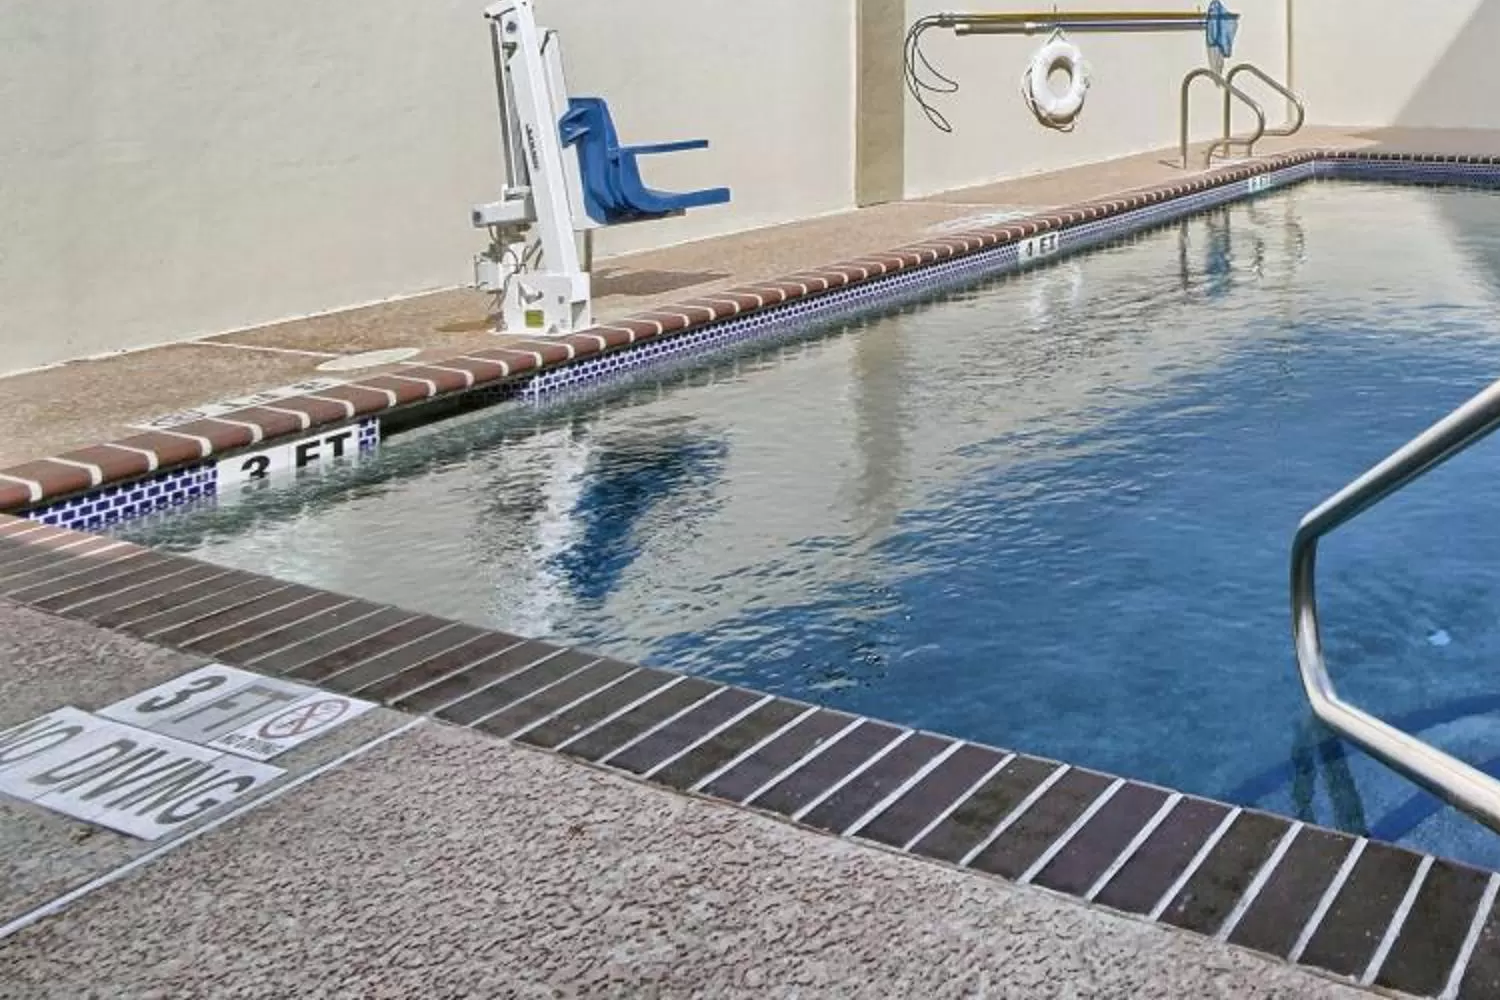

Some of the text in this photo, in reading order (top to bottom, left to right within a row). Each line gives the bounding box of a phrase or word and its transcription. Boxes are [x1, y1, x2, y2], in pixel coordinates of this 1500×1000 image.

[296, 431, 353, 469] FT
[135, 674, 291, 732] 3 FT
[27, 738, 257, 825] DIVING
